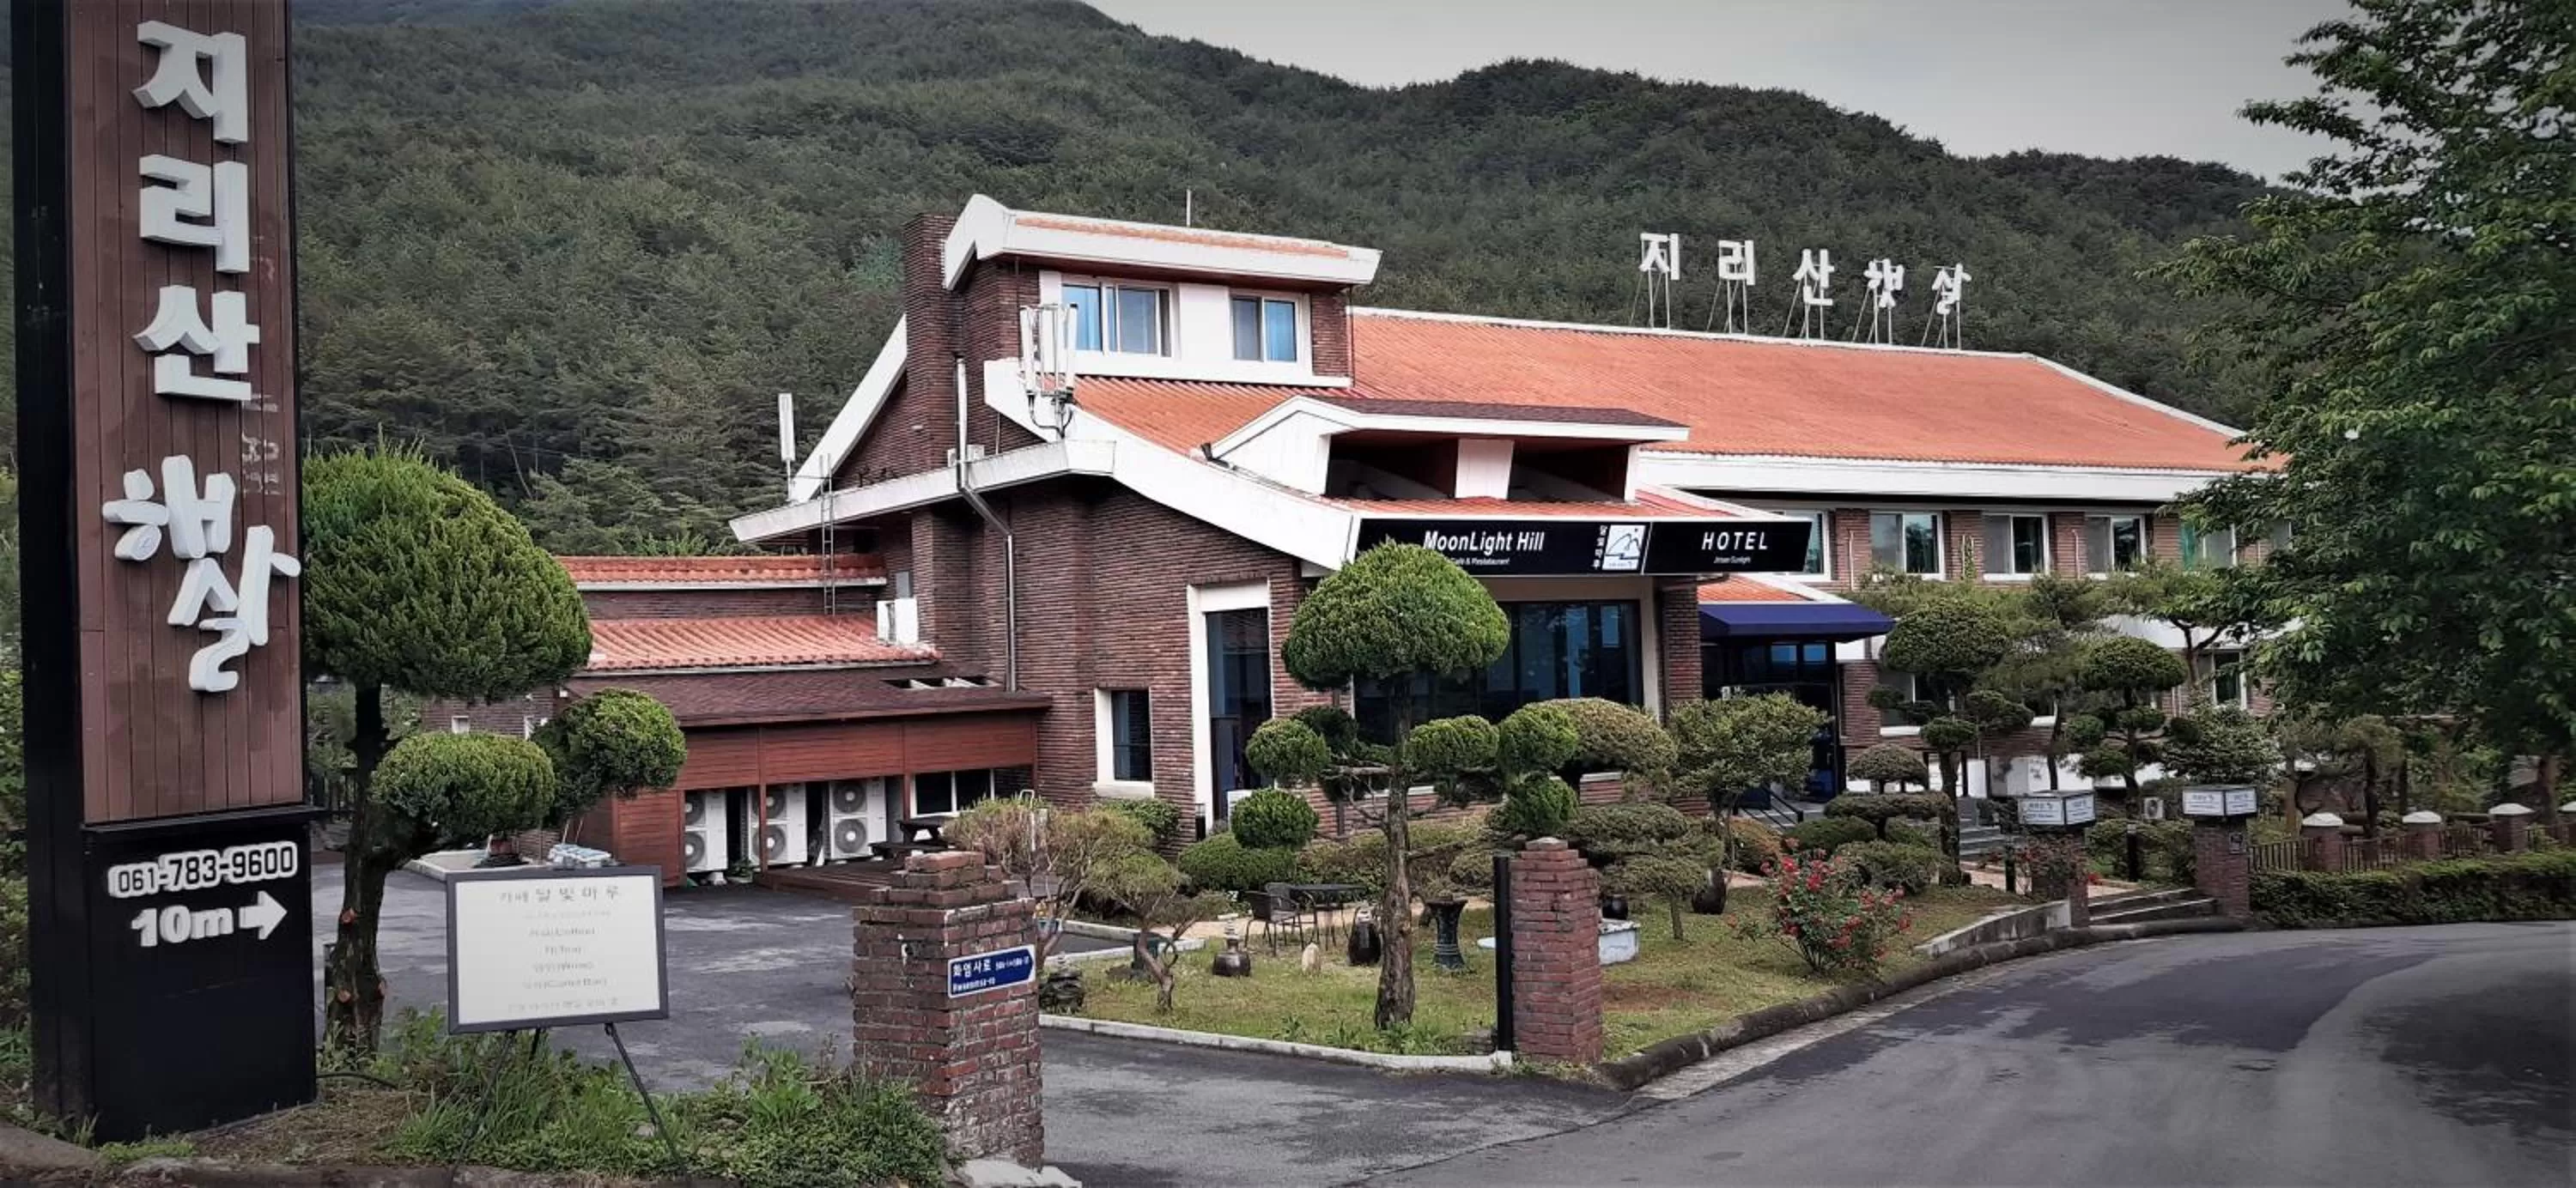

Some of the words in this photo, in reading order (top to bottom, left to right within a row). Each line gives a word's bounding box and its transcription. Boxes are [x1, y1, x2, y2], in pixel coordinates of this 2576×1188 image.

[132, 21, 260, 401] 지리산
[1639, 233, 1835, 306] 지리산
[1864, 258, 1972, 315] 햇살
[1423, 530, 1513, 556] MoonLight
[1516, 531, 1545, 551] Hill
[1701, 531, 1768, 550] HOTEL
[116, 845, 296, 894] 061-783-9600
[131, 904, 234, 948] 10m
